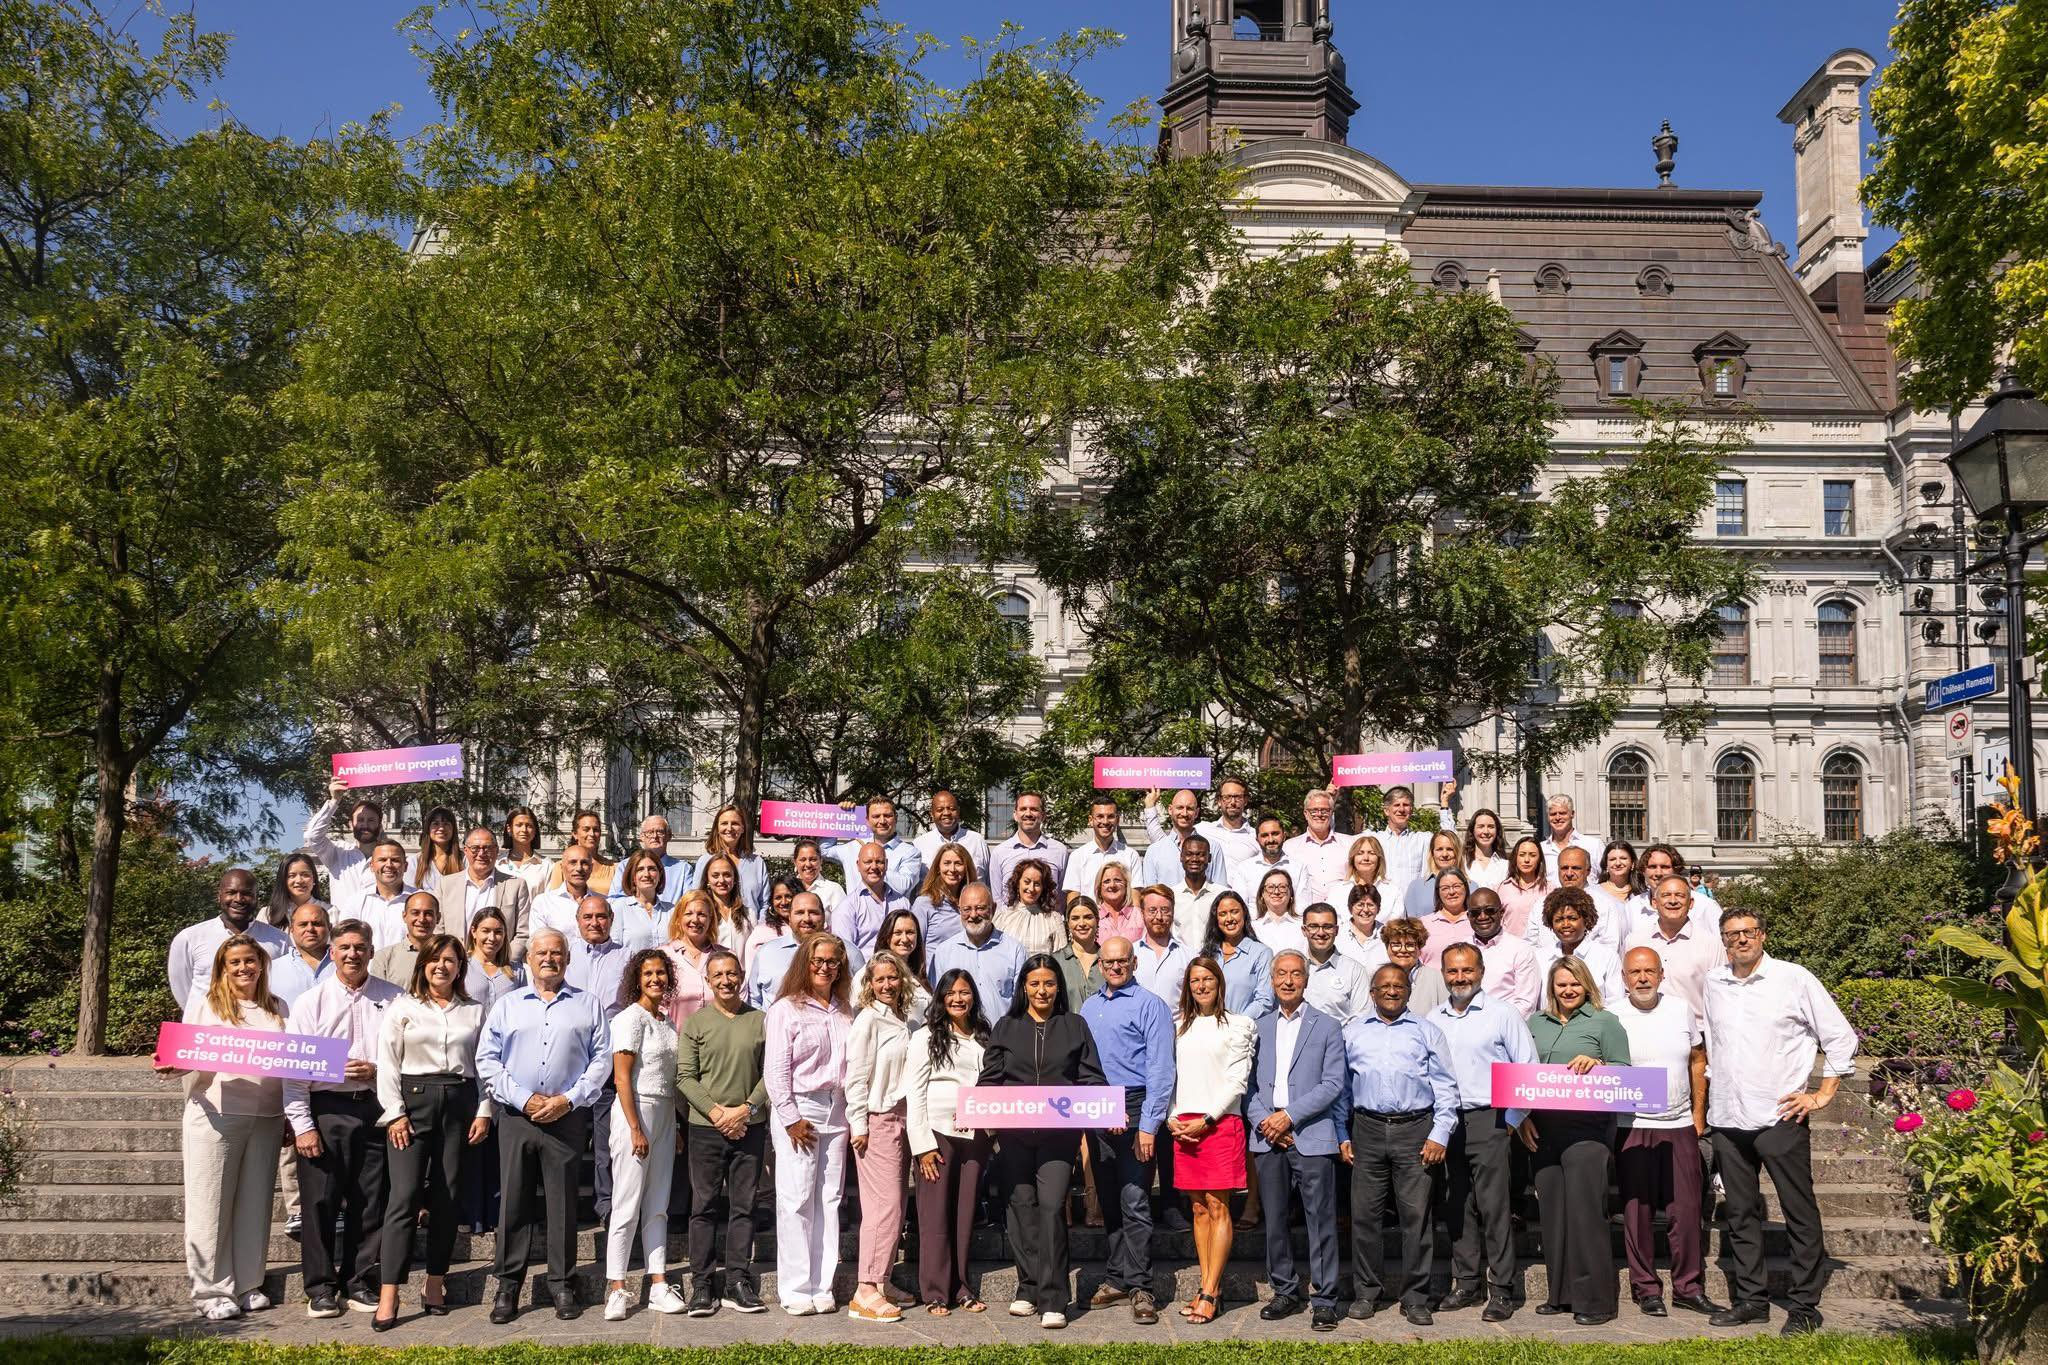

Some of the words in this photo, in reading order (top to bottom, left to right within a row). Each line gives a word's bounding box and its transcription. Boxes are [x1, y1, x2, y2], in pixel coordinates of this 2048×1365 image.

[1942, 684, 1965, 696] Château
[1966, 675, 1994, 688] Ramezay
[338, 763, 393, 776] Améliorer
[395, 761, 406, 771] la
[407, 755, 458, 772] propreté
[1102, 768, 1142, 777] Réduire
[1337, 765, 1389, 775] Renforcer
[1390, 765, 1401, 773] la
[1402, 760, 1447, 772] sécurité
[784, 808, 835, 820] Favoriser
[836, 812, 857, 821] une
[773, 819, 818, 829] mobilité
[819, 820, 868, 832] inclusive
[286, 1041, 298, 1053] à
[300, 1041, 317, 1055] la
[176, 1047, 217, 1062] crise
[221, 1048, 244, 1063] du
[247, 1052, 328, 1072] logement
[1536, 1071, 1580, 1085] Gérer
[1582, 1074, 1622, 1085] avec
[1515, 1083, 1572, 1100] rigueur
[1575, 1087, 1591, 1099] et
[1593, 1085, 1644, 1103] agilité
[965, 1096, 1046, 1115] Écouter
[1072, 1098, 1117, 1119] agir
